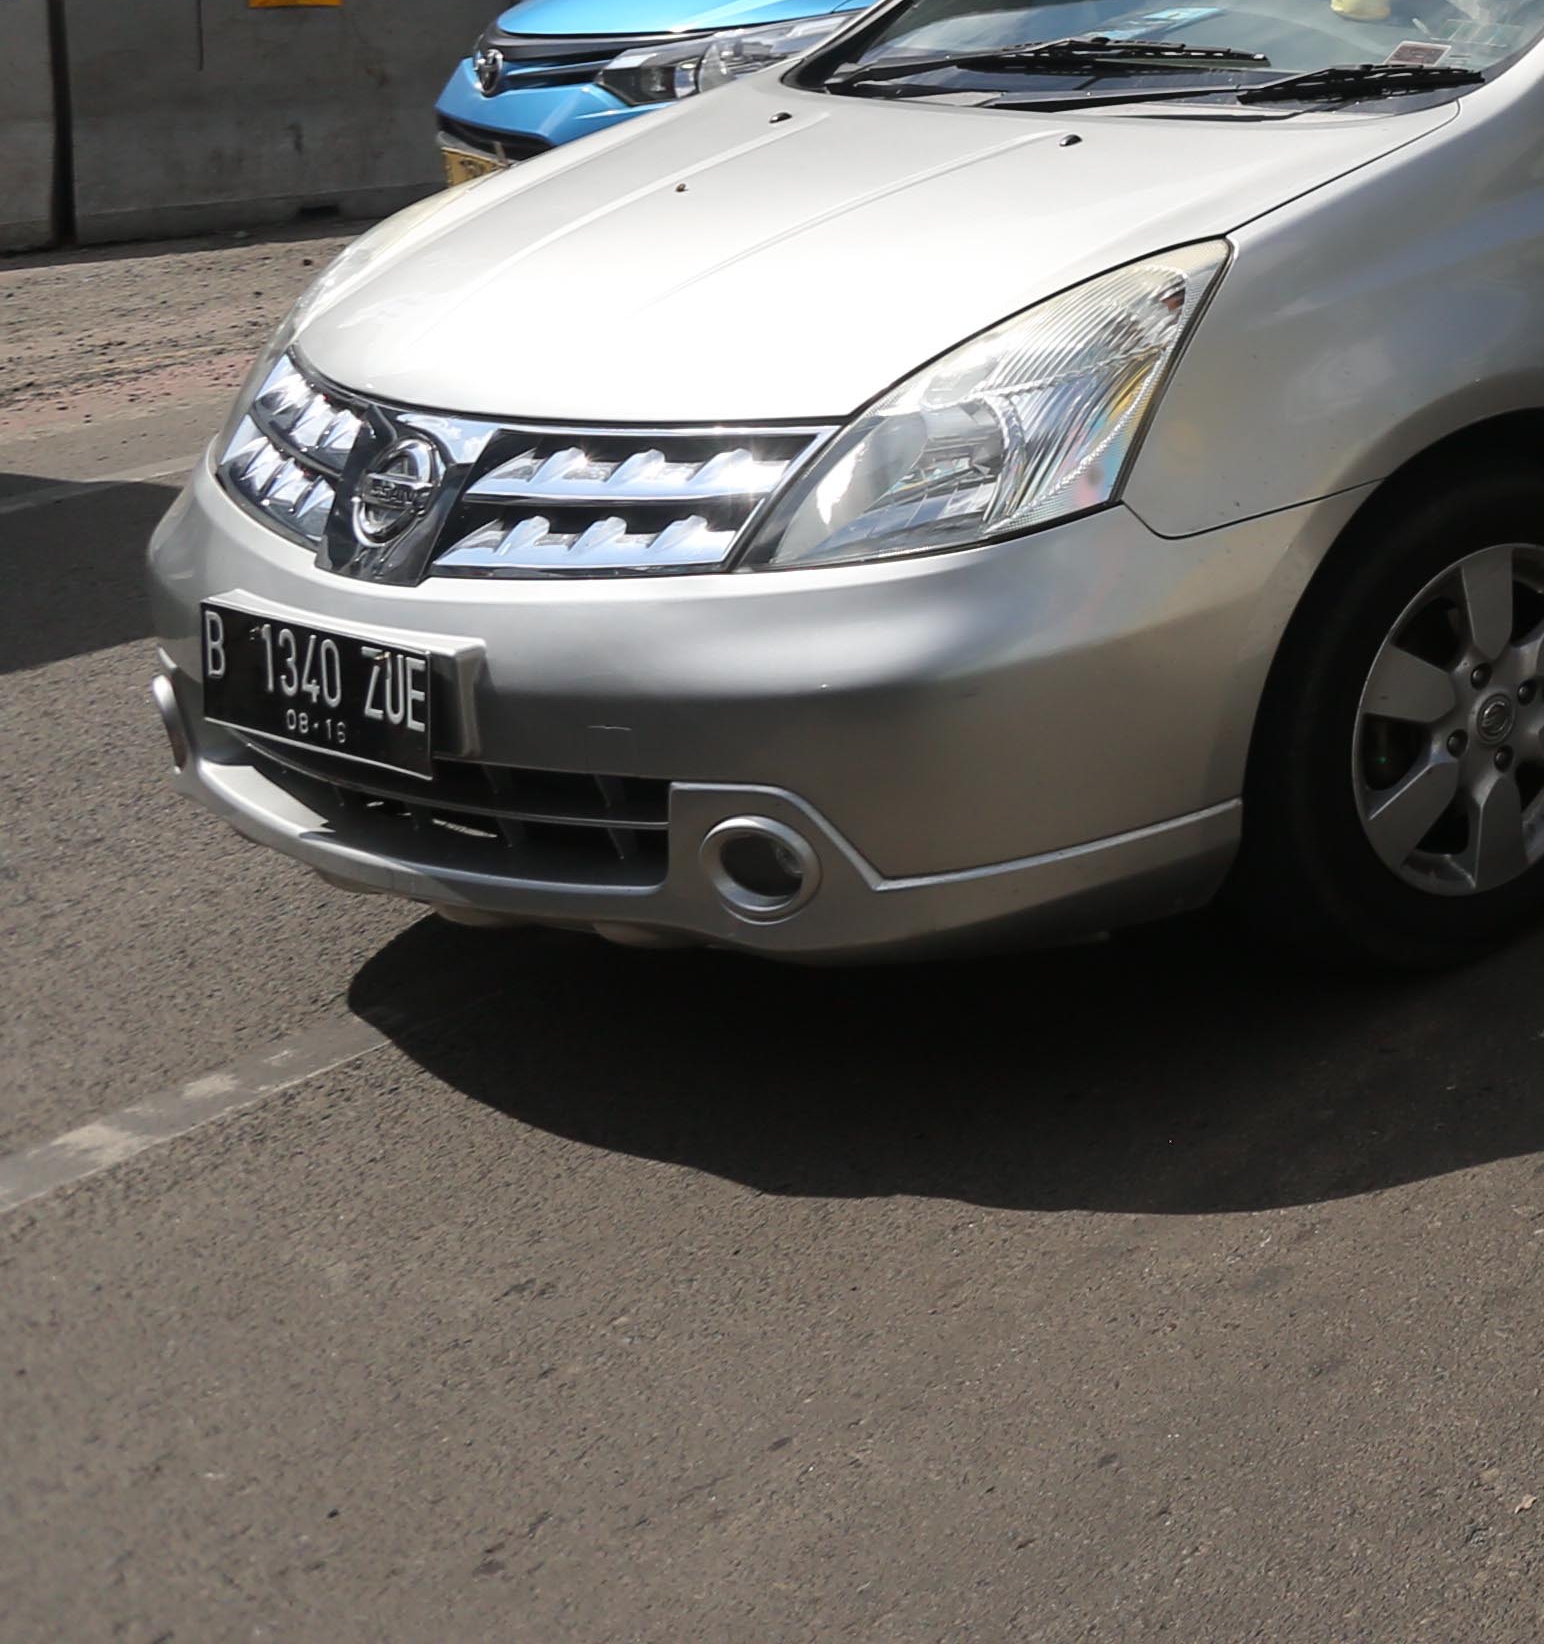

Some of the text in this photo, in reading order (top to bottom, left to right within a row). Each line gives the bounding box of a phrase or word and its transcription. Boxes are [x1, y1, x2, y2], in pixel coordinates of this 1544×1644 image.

[204, 611, 427, 733] B 1340 ZUE
